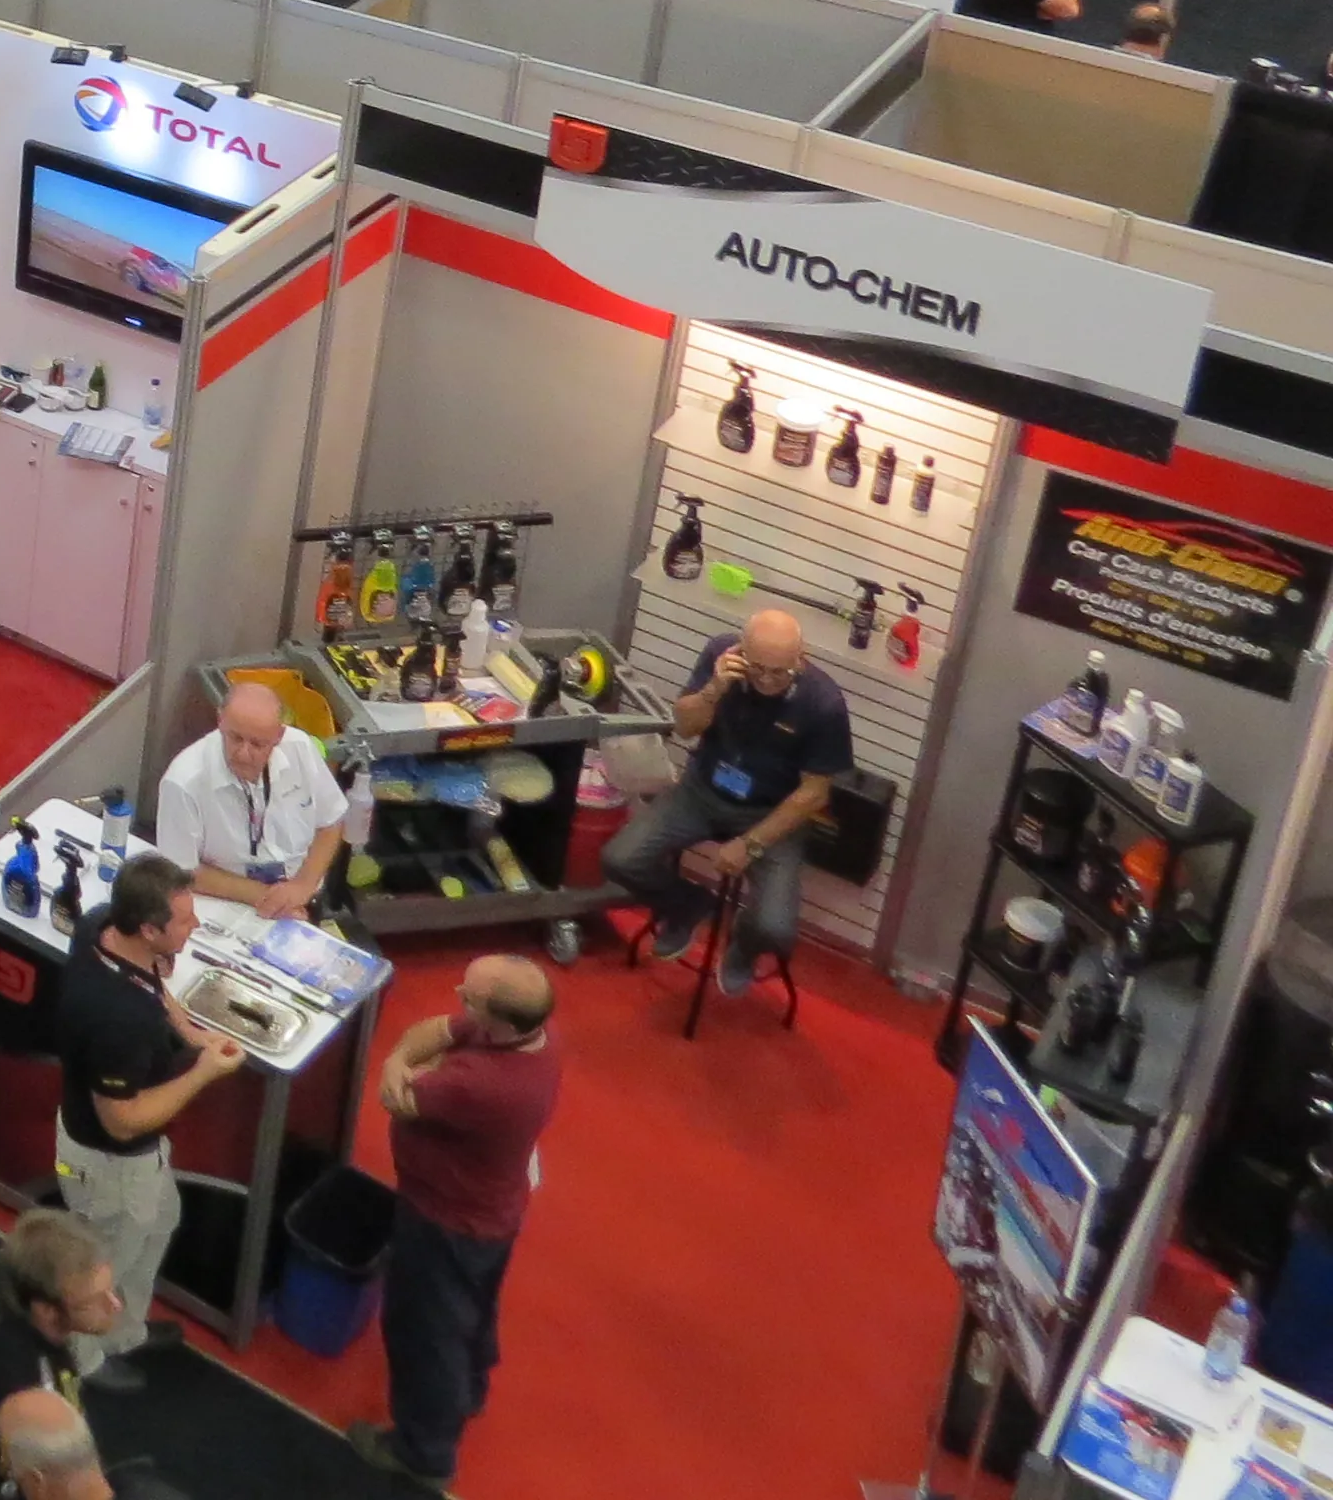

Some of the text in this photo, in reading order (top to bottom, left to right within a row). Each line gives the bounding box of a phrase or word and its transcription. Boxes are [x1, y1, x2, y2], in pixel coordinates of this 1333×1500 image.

[714, 231, 982, 338] AUTO-CHEM
[1050, 577, 1145, 618] Produits
[1148, 611, 1272, 661] d'entretien
[1067, 539, 1110, 564] Car
[1110, 553, 1163, 580] Care
[1167, 570, 1278, 616] Products
